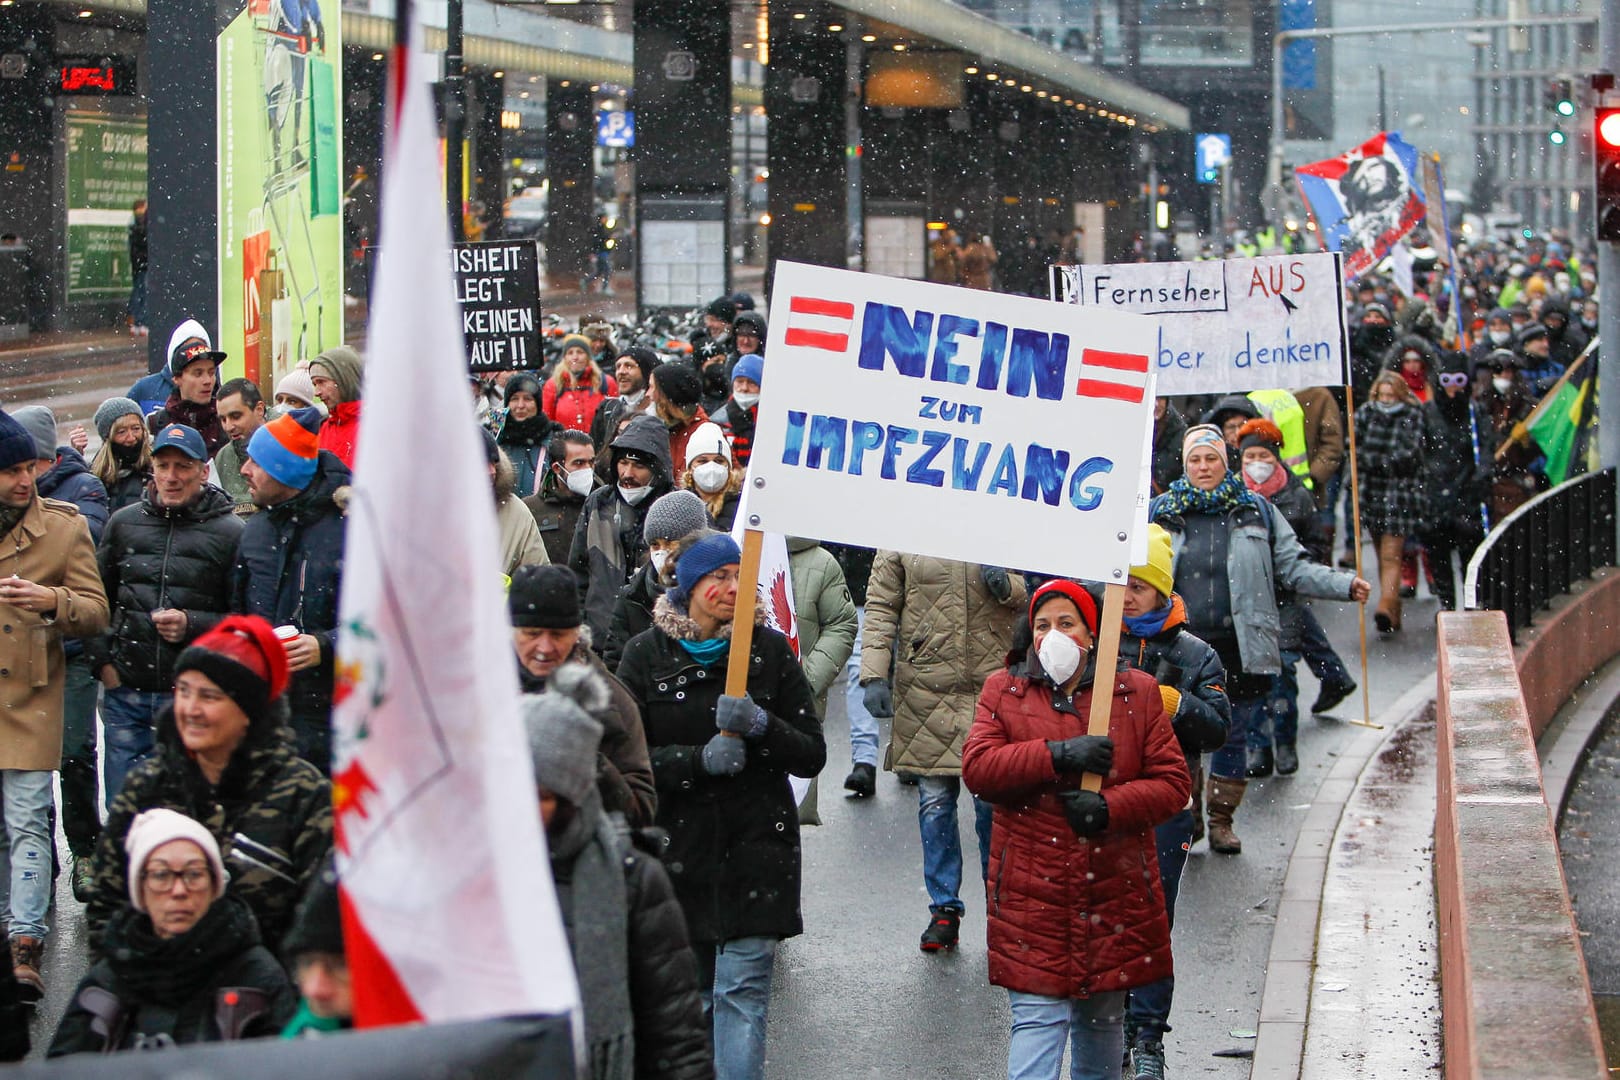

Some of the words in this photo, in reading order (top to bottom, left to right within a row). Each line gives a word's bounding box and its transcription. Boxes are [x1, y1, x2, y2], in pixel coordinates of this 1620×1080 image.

[452, 247, 521, 273] ISHEIT
[1095, 269, 1221, 305] Fernseher
[1248, 262, 1306, 298] AUS
[463, 308, 533, 333] KEINEN
[858, 302, 1070, 401] NEIN
[1157, 325, 1204, 369] ber
[1234, 327, 1331, 368] denken
[781, 410, 1114, 512] IMPFZWANG
